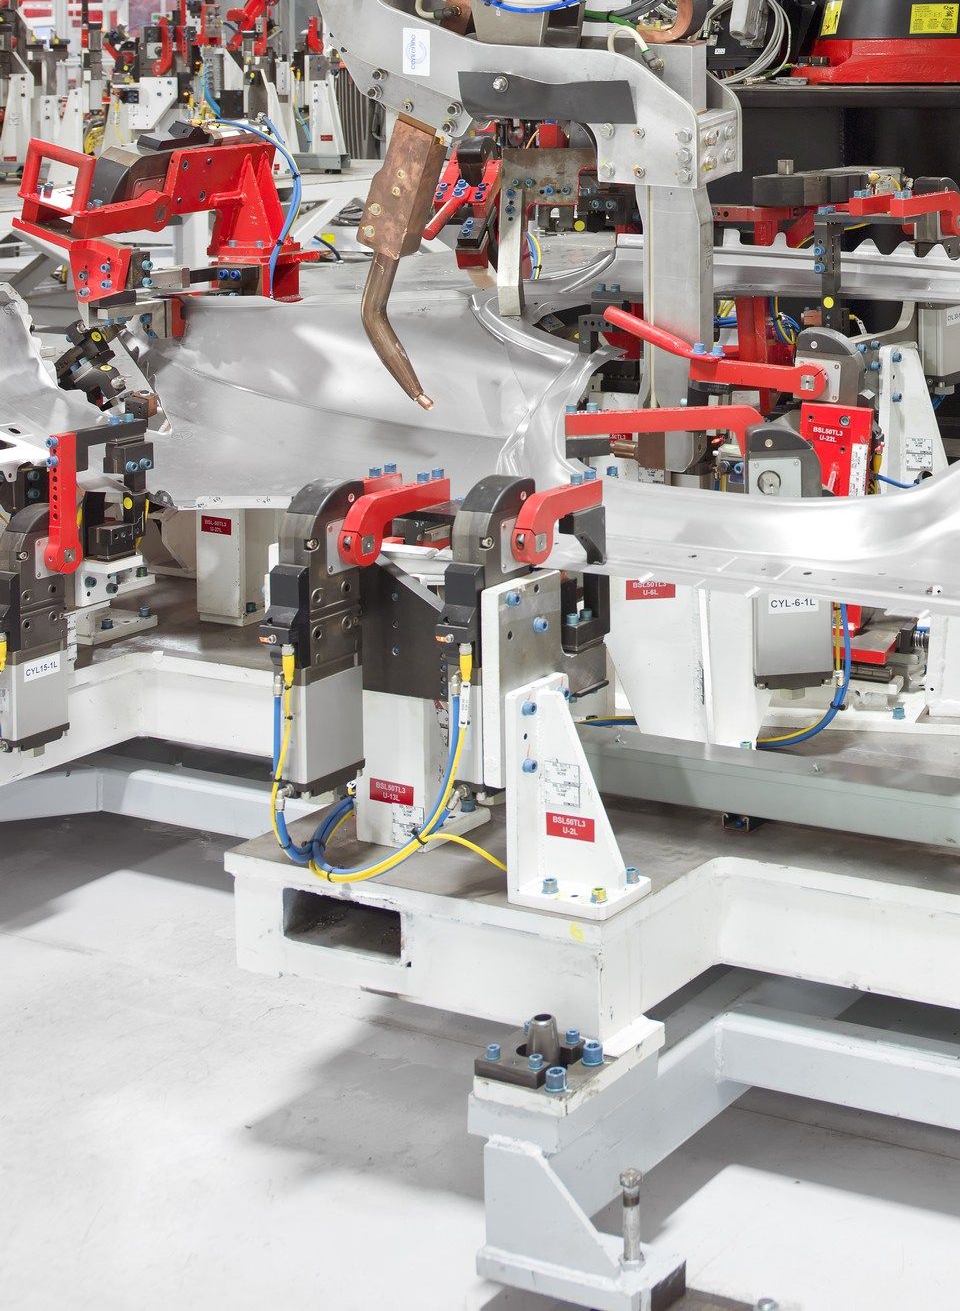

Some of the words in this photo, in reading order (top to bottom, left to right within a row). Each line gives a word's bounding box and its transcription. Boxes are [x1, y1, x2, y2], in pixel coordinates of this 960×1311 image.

[813, 426, 844, 437] BSL50TL3
[770, 598, 816, 608] CYL-6-1L
[25, 661, 58, 677] CYL15-1L
[375, 781, 406, 794] BSL50TL3
[552, 815, 586, 828] BSL50TL3
